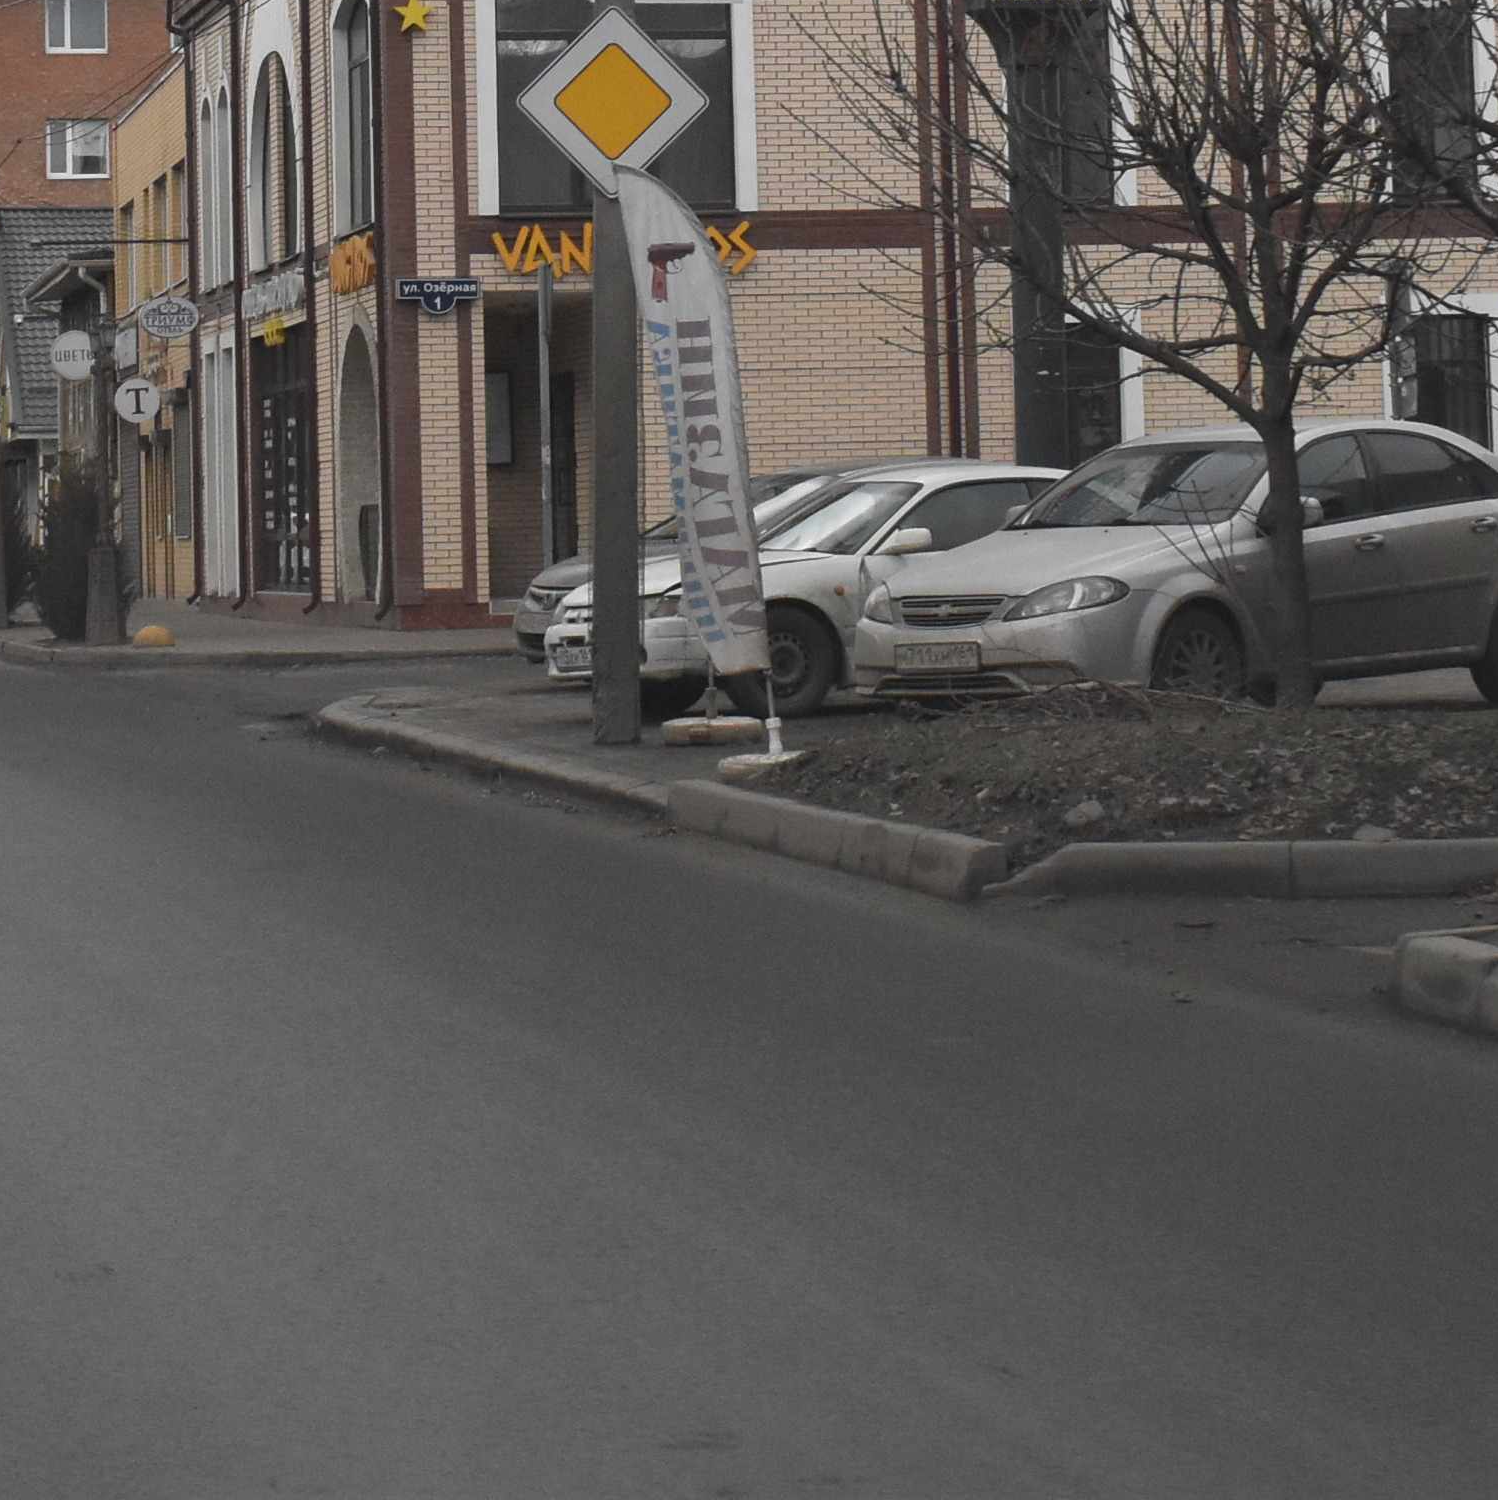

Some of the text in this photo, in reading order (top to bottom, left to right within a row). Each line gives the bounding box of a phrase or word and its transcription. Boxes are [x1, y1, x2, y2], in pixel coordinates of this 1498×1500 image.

[402, 282, 476, 296] ул. Озёрная
[433, 297, 442, 310] 1
[144, 314, 196, 327] ТРИУМФ
